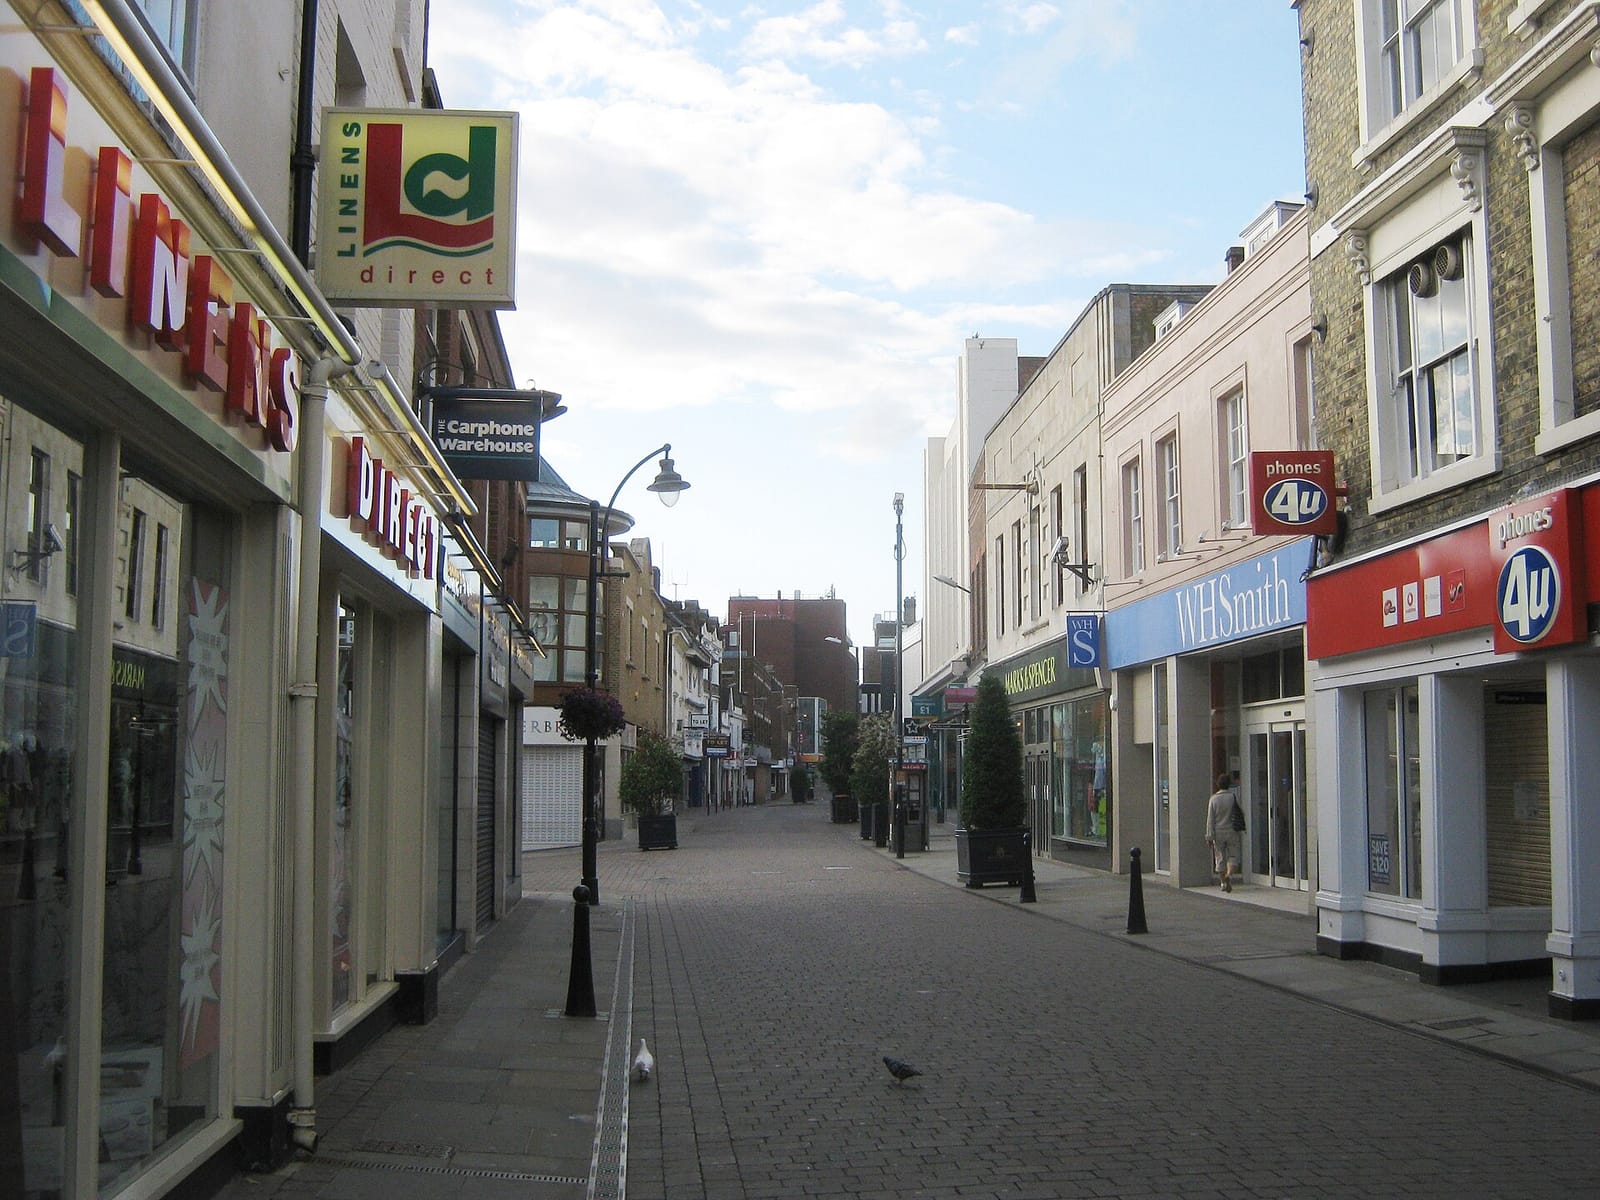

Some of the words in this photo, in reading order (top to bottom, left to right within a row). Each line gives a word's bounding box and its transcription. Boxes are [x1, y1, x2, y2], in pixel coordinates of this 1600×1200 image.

[337, 121, 362, 258] LINENS
[22, 66, 302, 453] LINENS
[360, 265, 494, 285] direct
[438, 419, 446, 433] THE
[439, 438, 534, 453] Warehouse
[447, 420, 535, 437] Carphone
[1266, 460, 1321, 478] phones
[350, 436, 440, 580] DIRECT
[1271, 482, 1322, 521] 4u
[1498, 506, 1553, 549] phones
[1175, 555, 1291, 649] WHSmith
[1502, 553, 1550, 637] 4u
[1371, 840, 1389, 855] SAVE
